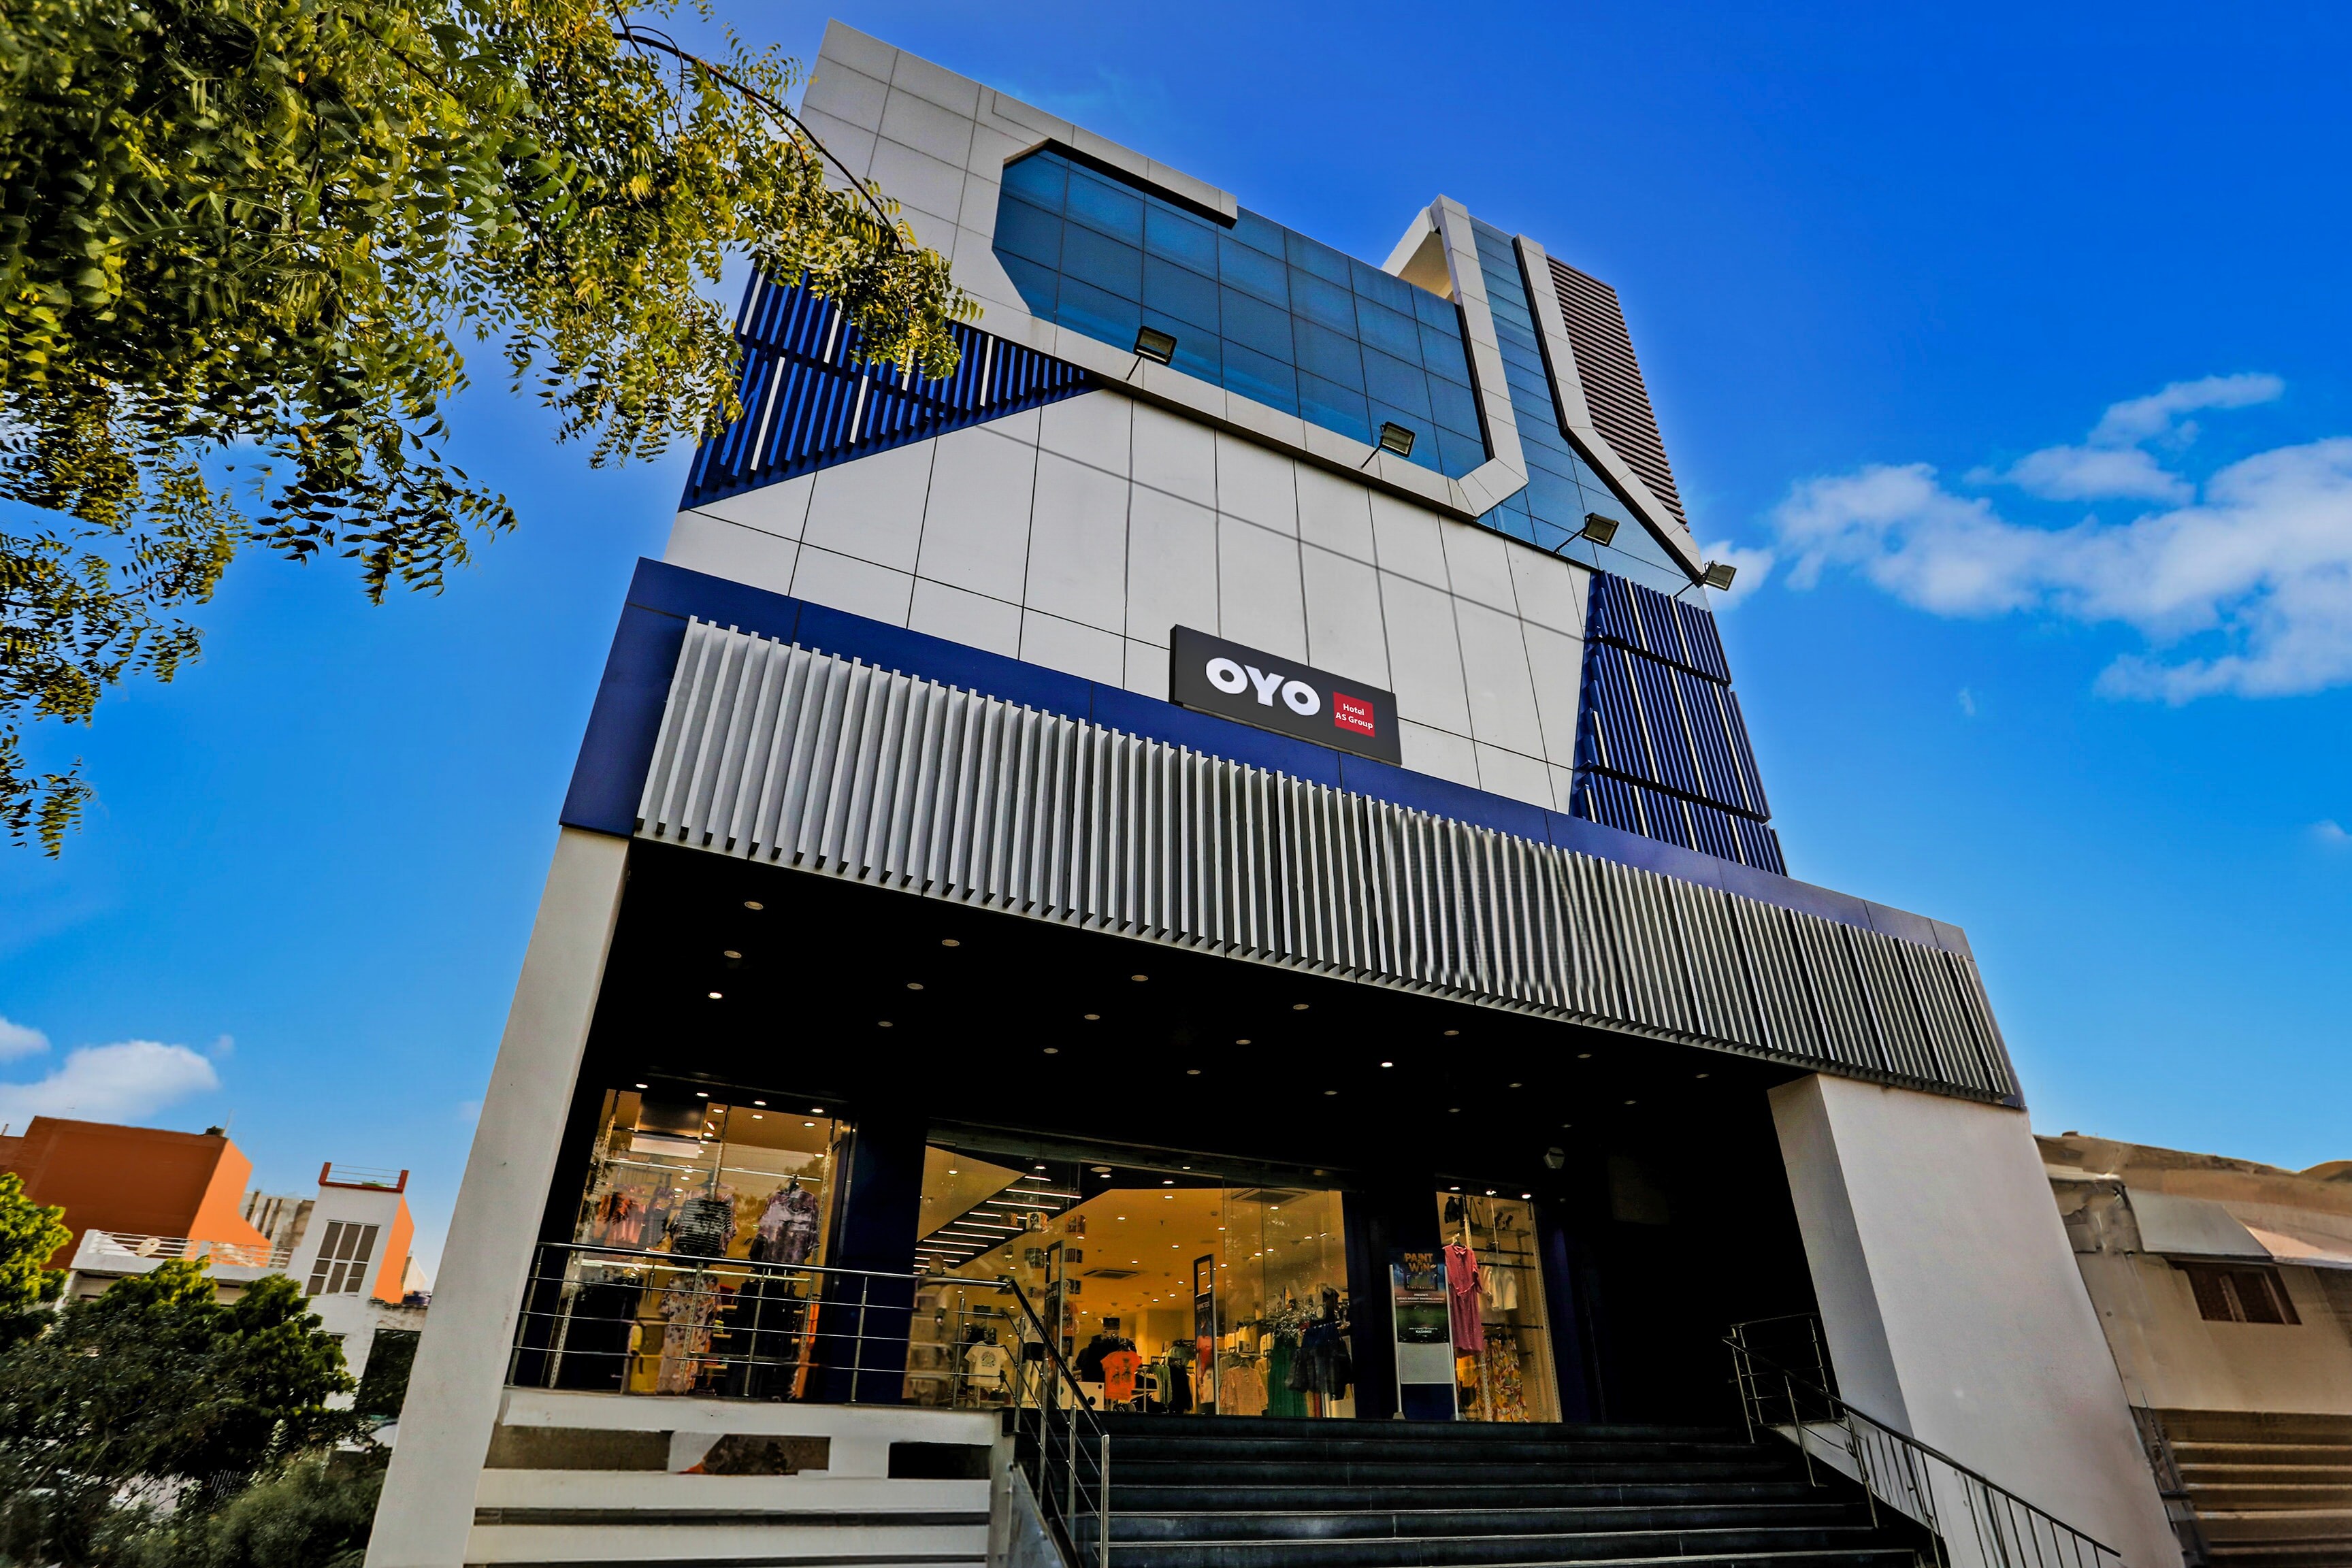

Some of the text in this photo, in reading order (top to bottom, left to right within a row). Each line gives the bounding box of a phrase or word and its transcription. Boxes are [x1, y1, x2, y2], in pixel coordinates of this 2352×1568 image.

[1206, 657, 1321, 716] OYO
[1343, 703, 1365, 716] Hotel
[1335, 712, 1373, 730] AS Group
[1404, 1252, 1433, 1262] PAINT
